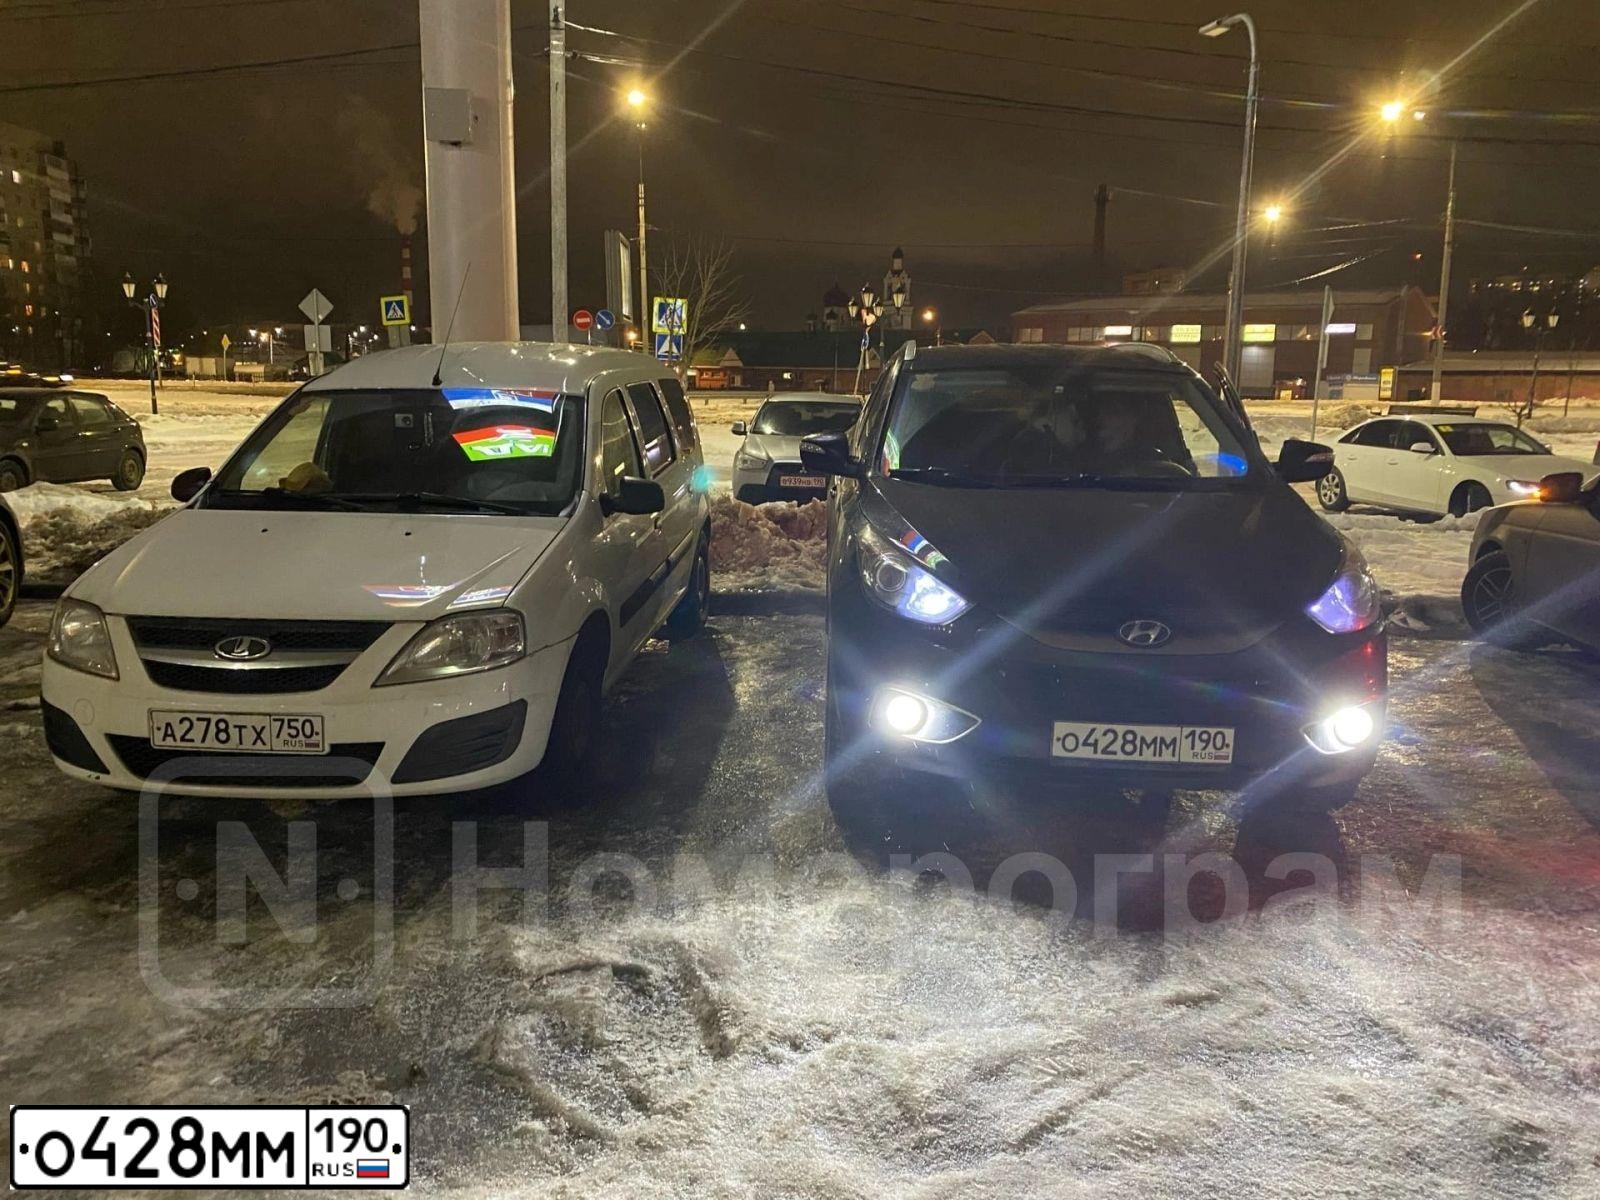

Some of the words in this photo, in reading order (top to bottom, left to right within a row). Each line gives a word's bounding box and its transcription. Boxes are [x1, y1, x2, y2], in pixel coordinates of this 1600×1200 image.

[161, 716, 267, 746] А278ТХ
[273, 718, 315, 739] 750
[283, 739, 304, 748] RUS
[1061, 727, 1177, 758] О428ММ
[1184, 729, 1226, 751] 190
[1192, 751, 1214, 760] RUS
